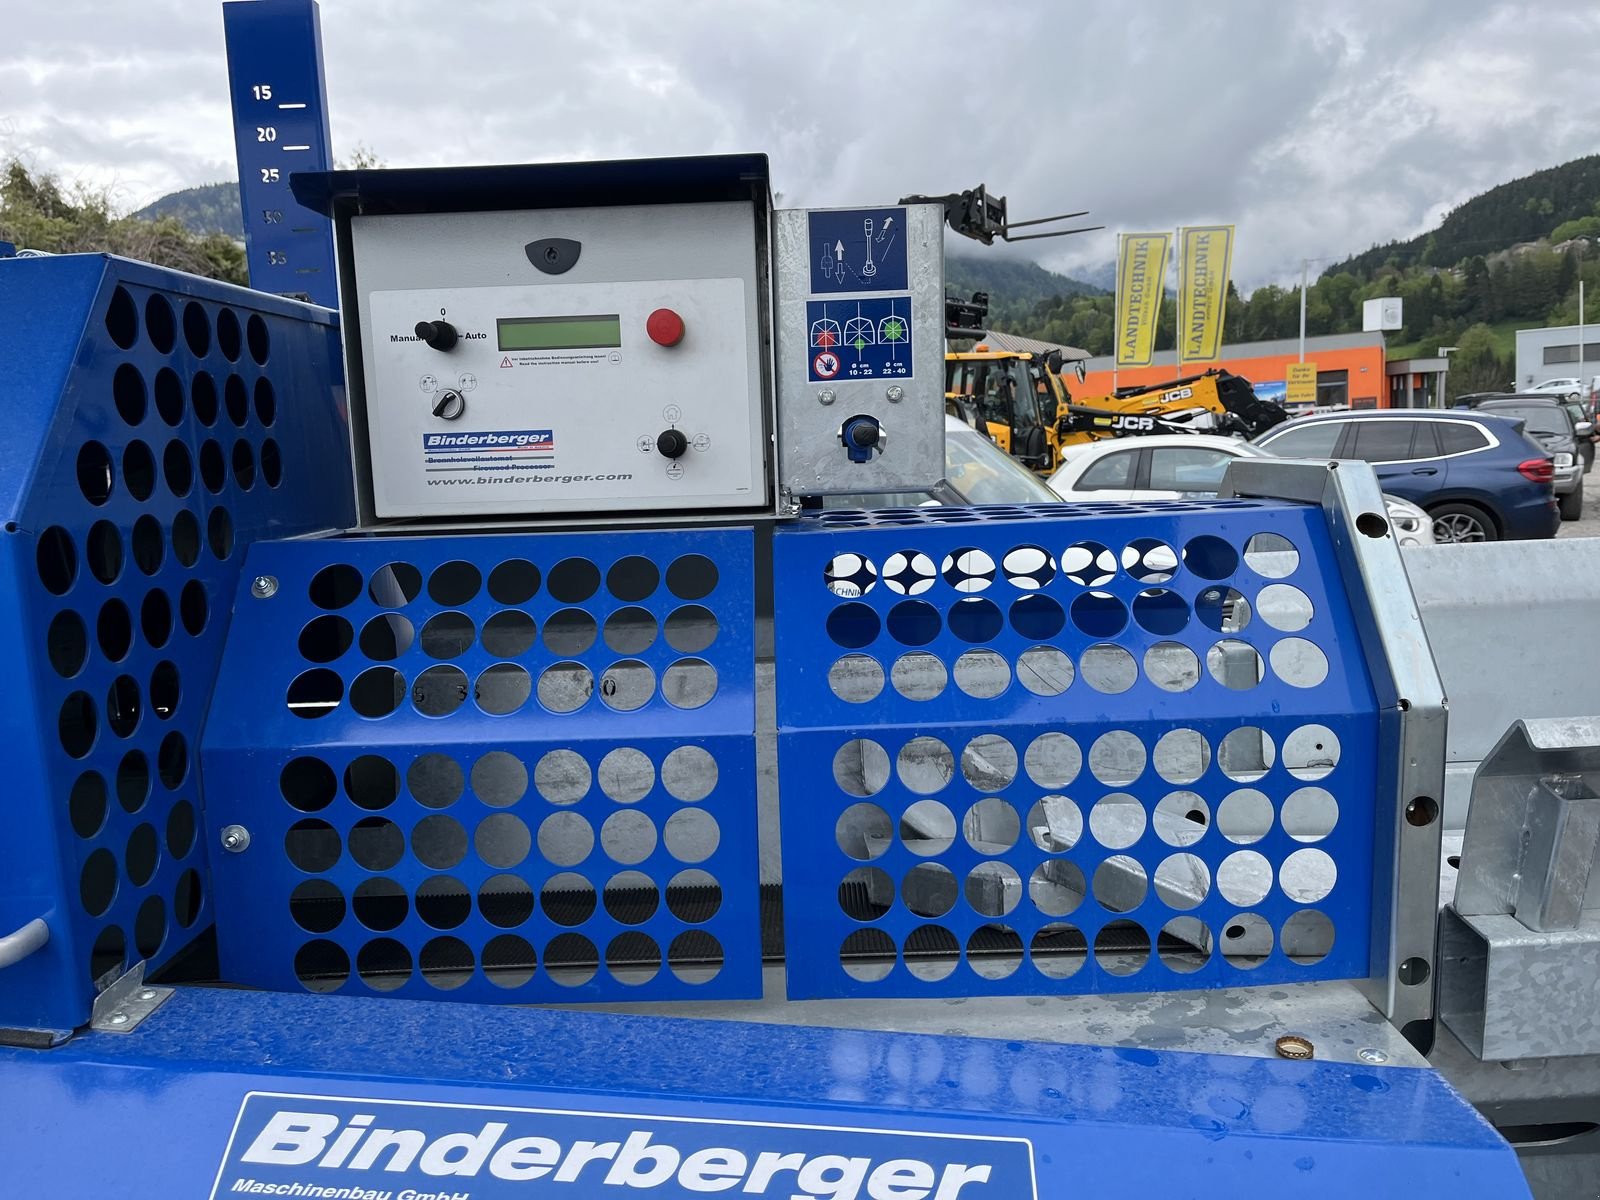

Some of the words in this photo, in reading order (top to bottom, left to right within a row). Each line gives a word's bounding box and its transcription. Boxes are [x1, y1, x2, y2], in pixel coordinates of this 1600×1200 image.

[253, 85, 272, 100] 15
[257, 127, 276, 142] 20
[261, 168, 279, 183] 25
[1123, 240, 1149, 361] LANDTECHNIK
[1189, 233, 1211, 355] LANDTECHNIK
[440, 307, 447, 316] 0
[390, 334, 426, 342] Manua
[465, 332, 487, 340] Auto
[1160, 387, 1193, 403] JCB
[1111, 416, 1154, 430] JCB
[427, 434, 549, 446] Binderberger
[427, 473, 633, 486] www.binderberger.com
[241, 1111, 992, 1200] Binderberger
[231, 1178, 392, 1200] Maschinenbau
